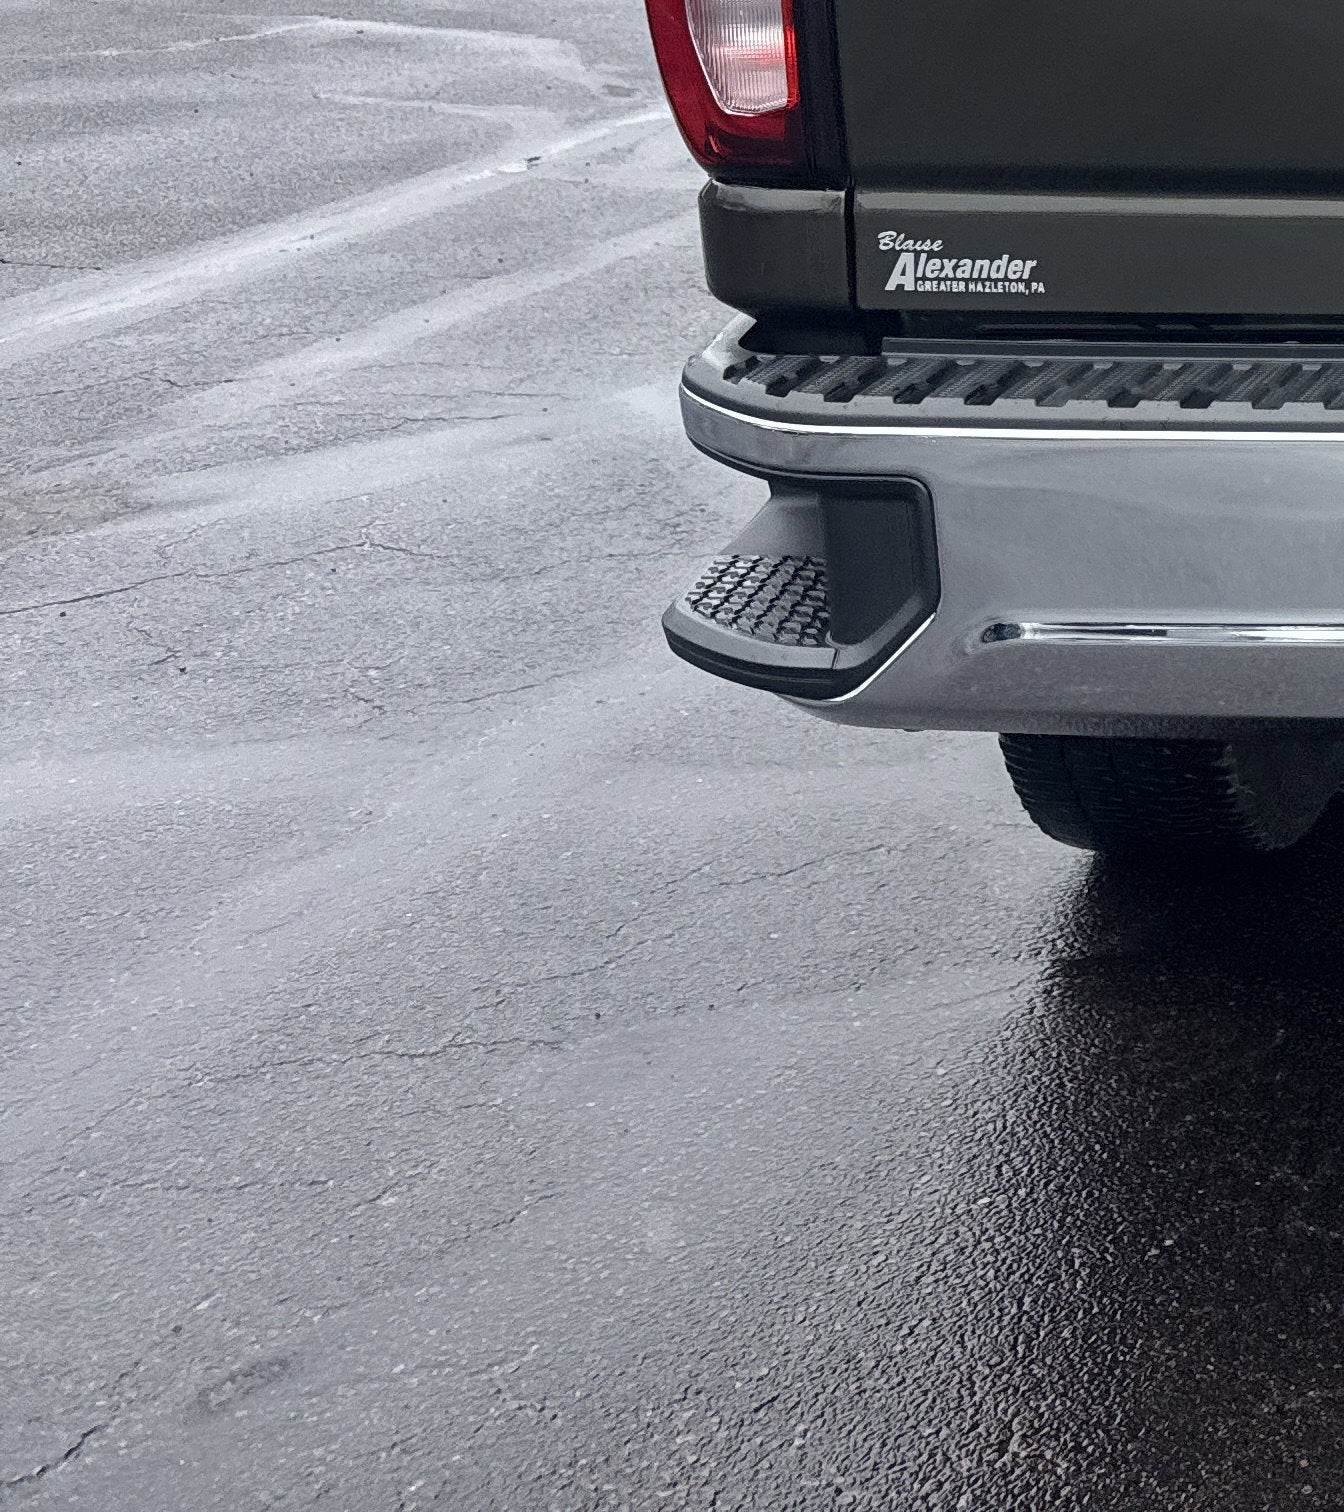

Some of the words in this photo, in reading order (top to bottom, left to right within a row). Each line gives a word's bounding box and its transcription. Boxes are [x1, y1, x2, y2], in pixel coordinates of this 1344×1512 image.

[877, 230, 944, 251] Blaise
[884, 252, 1038, 291] Alexander
[916, 280, 966, 293] GREATER
[968, 280, 1029, 295] HAZLETON,
[1030, 281, 1046, 294] PA
